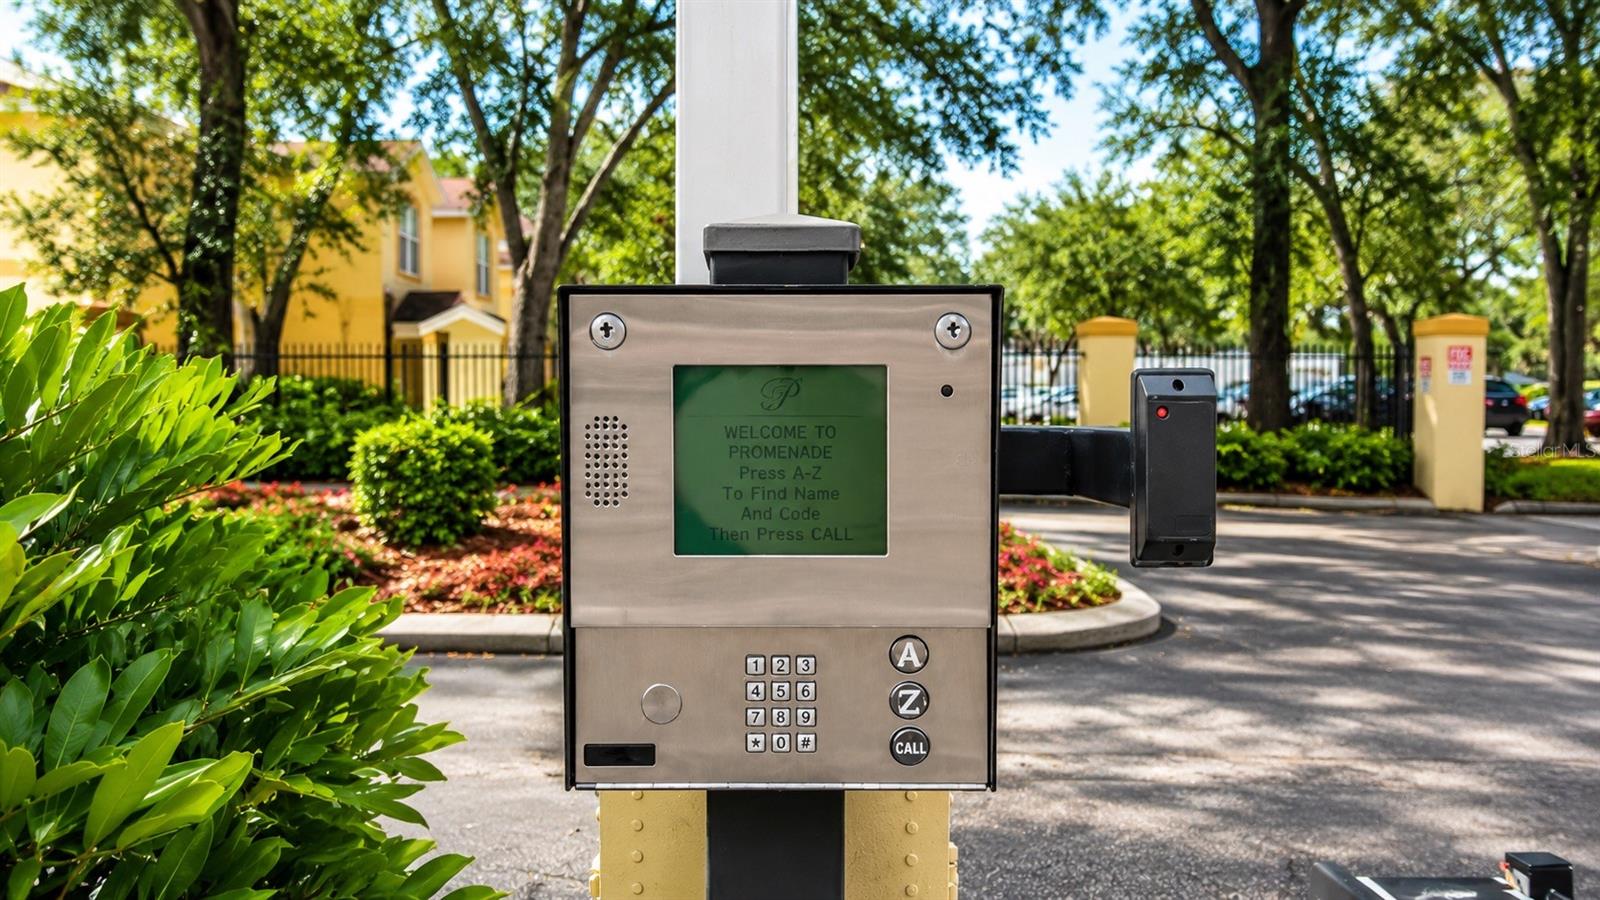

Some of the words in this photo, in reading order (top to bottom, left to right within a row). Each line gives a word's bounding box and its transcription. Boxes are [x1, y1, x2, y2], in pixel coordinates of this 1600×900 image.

[724, 425, 807, 439] WELCOME
[814, 425, 837, 439] TO
[729, 445, 833, 459] PROMENADE
[739, 466, 786, 480] Press
[792, 466, 822, 480] A-Z
[722, 486, 744, 500] To
[751, 486, 787, 500] Find
[794, 486, 840, 500] Name
[740, 506, 772, 520] And
[779, 506, 820, 520] Code
[709, 527, 749, 541] Then
[757, 527, 804, 541] Press
[811, 527, 853, 541] CALL
[896, 641, 922, 667] A
[752, 659, 759, 672] 1
[776, 659, 785, 672] 2
[802, 659, 810, 672] 3
[751, 684, 760, 698] 4
[776, 684, 786, 698] 5
[801, 684, 811, 698] 6
[898, 689, 921, 715] Z
[751, 711, 760, 723] 7
[776, 711, 785, 724] 8
[801, 711, 811, 724] 9
[776, 736, 786, 749] 0
[895, 742, 927, 755] CALL
